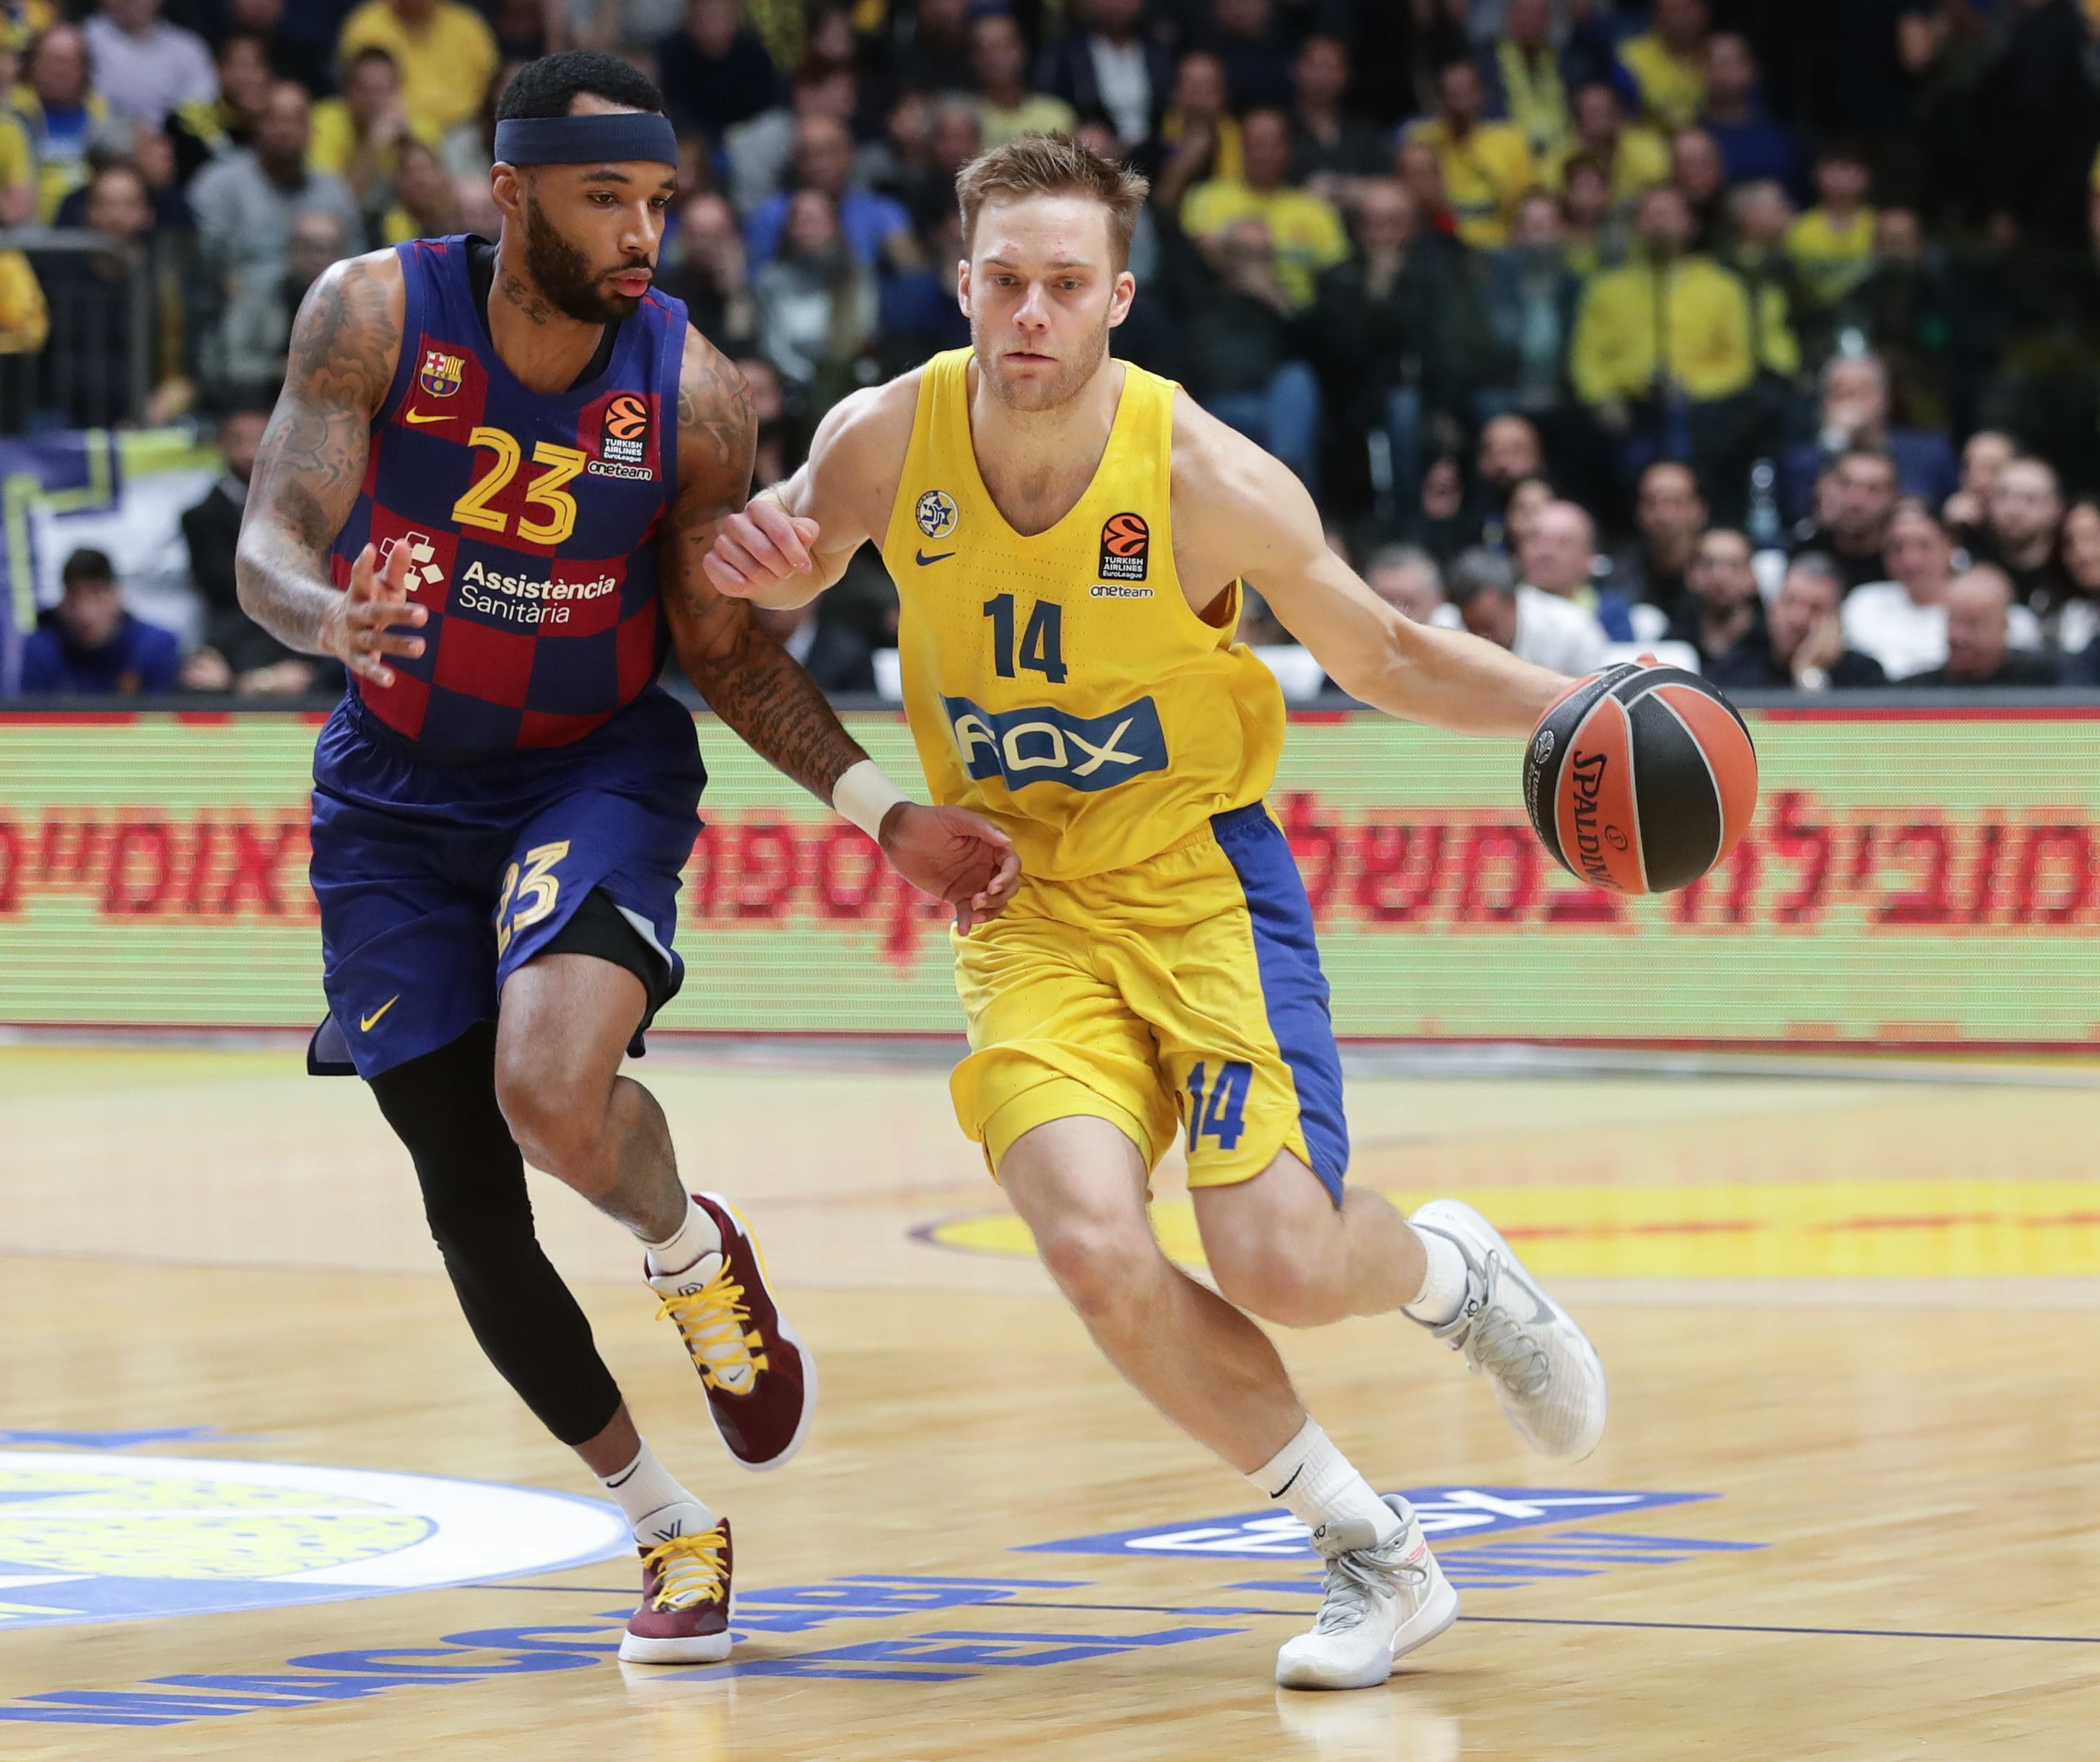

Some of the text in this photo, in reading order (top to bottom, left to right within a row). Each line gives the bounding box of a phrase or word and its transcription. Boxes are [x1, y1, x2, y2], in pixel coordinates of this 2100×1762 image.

[604, 446, 642, 456] AIRLINES
[605, 438, 643, 449] TURKISH
[604, 452, 642, 463] EuroLeague
[451, 427, 588, 545] 23
[1103, 564, 1143, 572] AIRLINES
[1105, 557, 1143, 565] TURKISH
[462, 560, 616, 600] Assistència
[1102, 570, 1143, 580] EuroLeague
[458, 585, 570, 624] Sanitària
[983, 593, 1068, 684] 14
[496, 839, 571, 961] 23
[1187, 1060, 1254, 1153] 14
